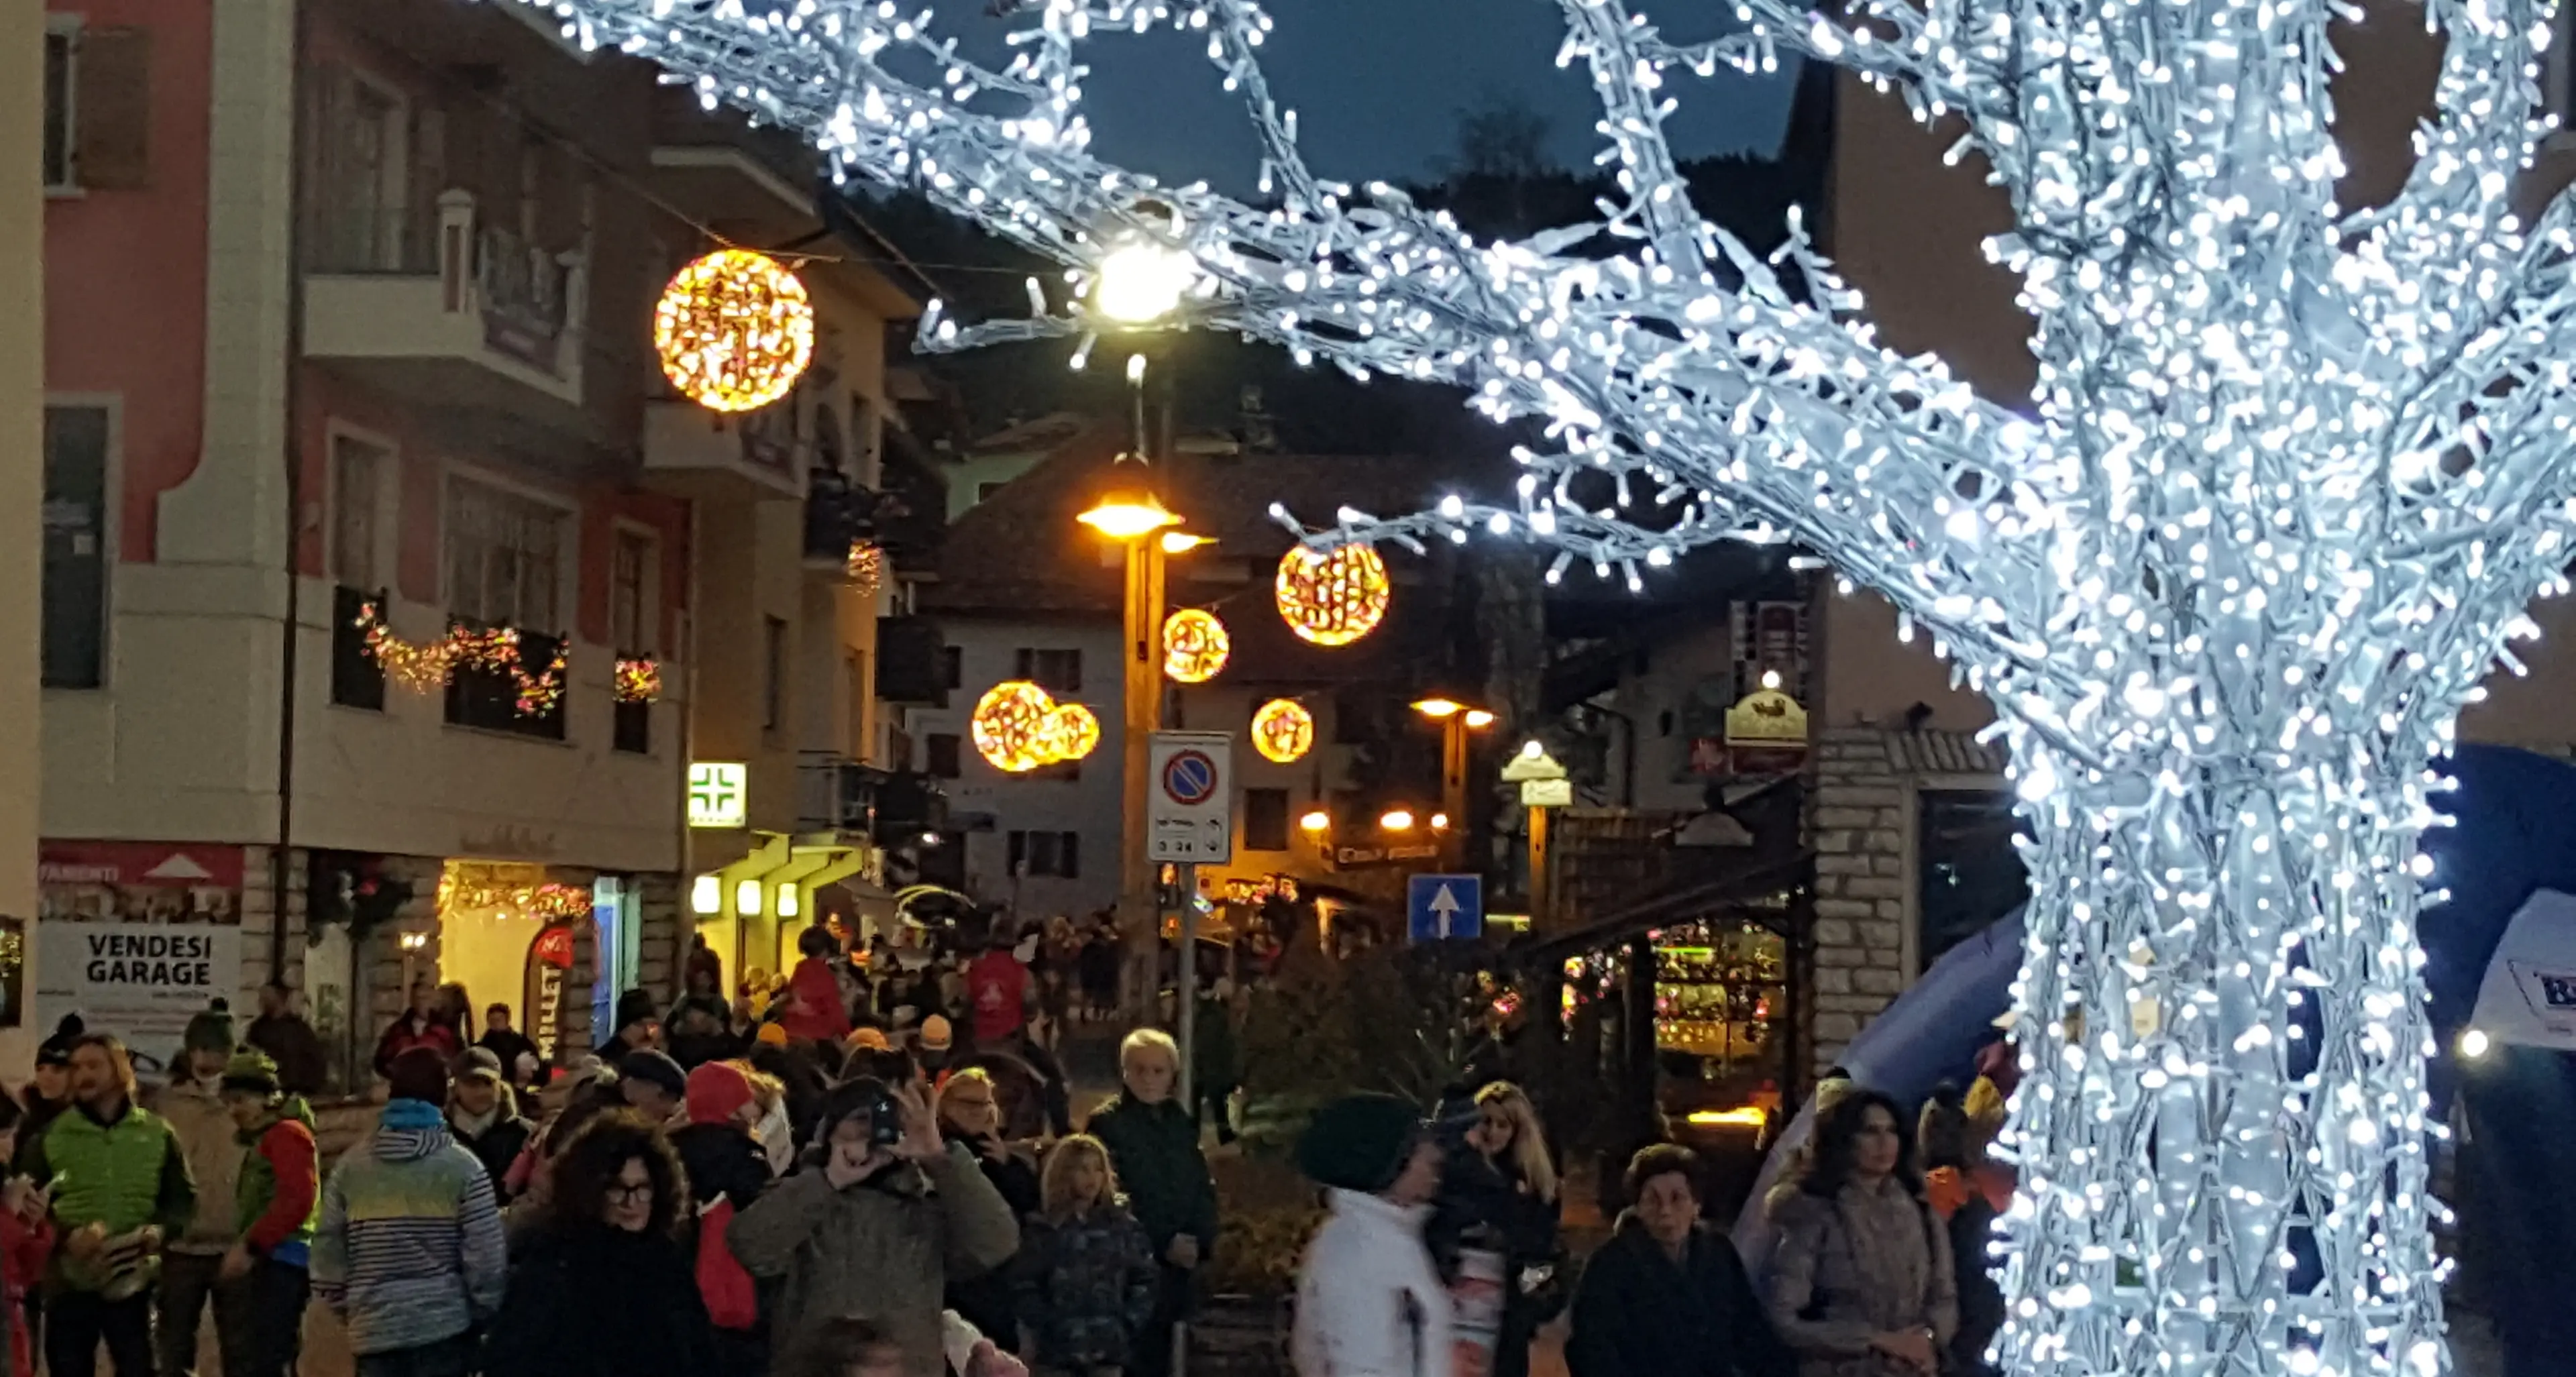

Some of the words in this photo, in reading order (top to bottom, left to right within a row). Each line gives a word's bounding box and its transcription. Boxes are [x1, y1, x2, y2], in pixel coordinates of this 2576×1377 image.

[87, 934, 212, 959] VENDESI
[87, 960, 211, 985] GARAGE
[537, 965, 563, 1060] MILLET
